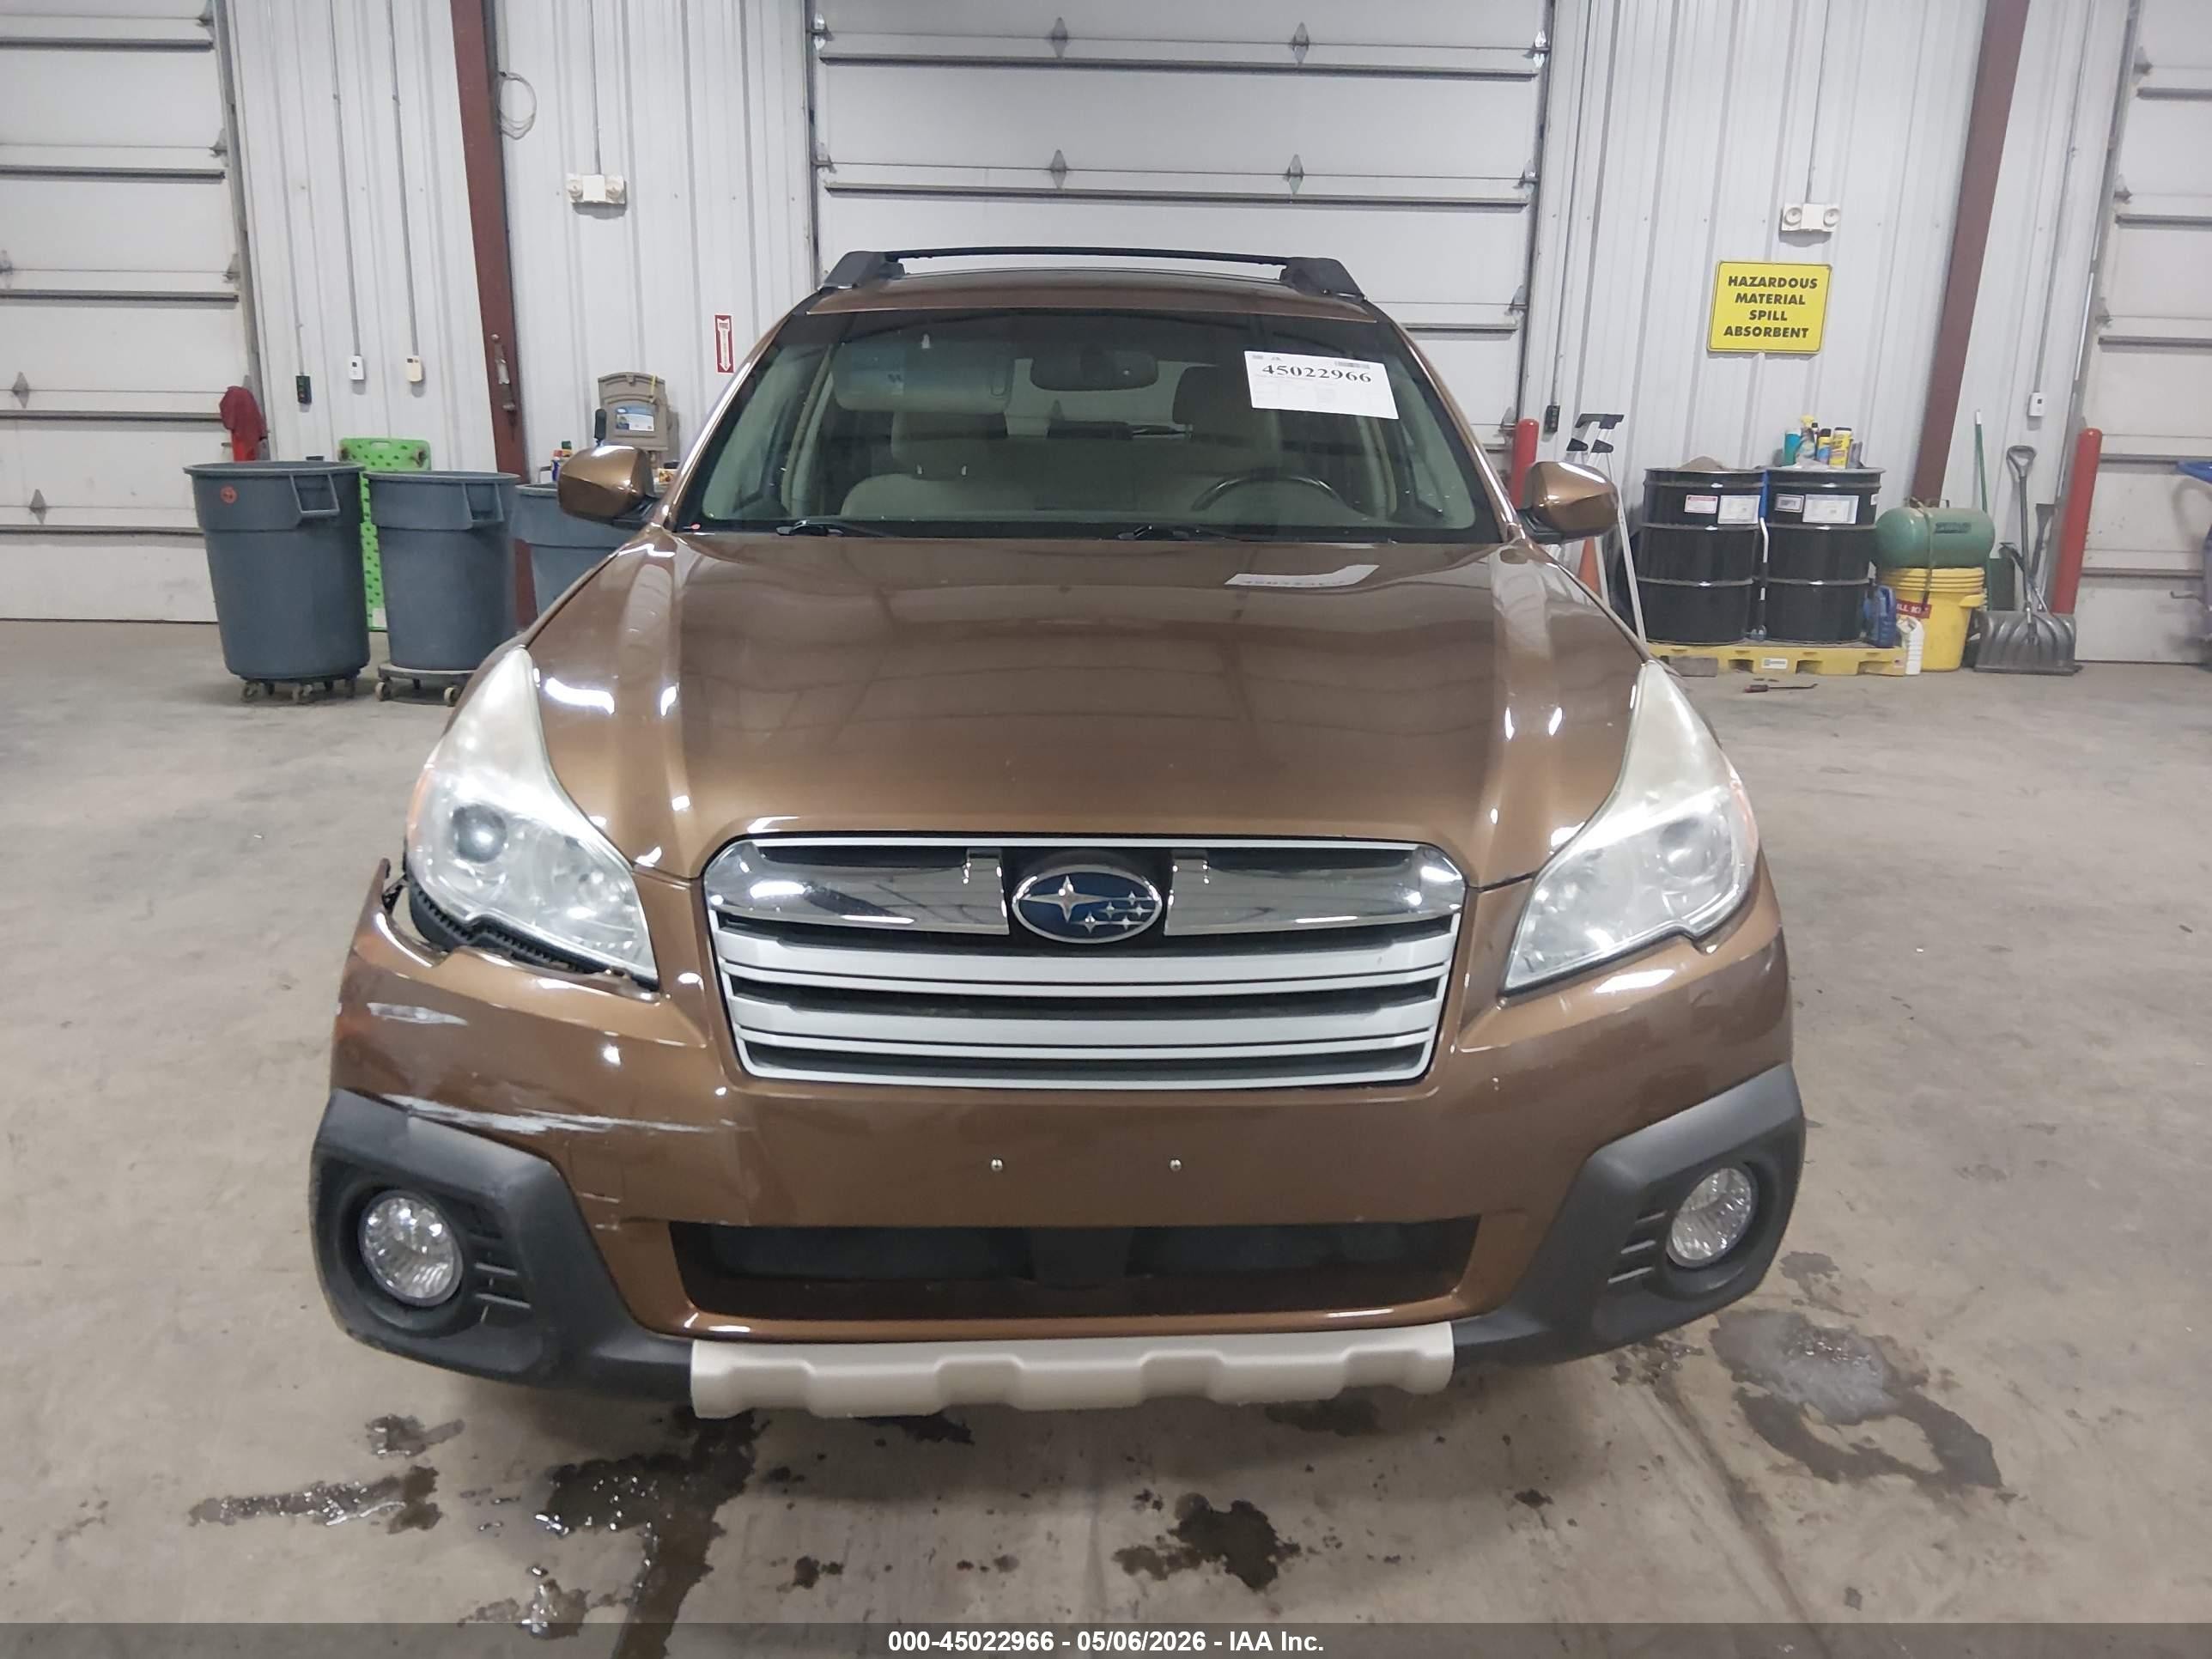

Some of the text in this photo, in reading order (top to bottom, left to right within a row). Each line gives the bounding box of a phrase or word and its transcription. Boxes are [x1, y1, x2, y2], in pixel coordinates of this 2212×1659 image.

[1728, 276, 1818, 289] HAZARDOUS
[1735, 293, 1806, 305] MATERIAL
[1748, 310, 1788, 321] SPILL
[1723, 325, 1809, 338] ABSORBENT
[1262, 364, 1372, 383] 45022966
